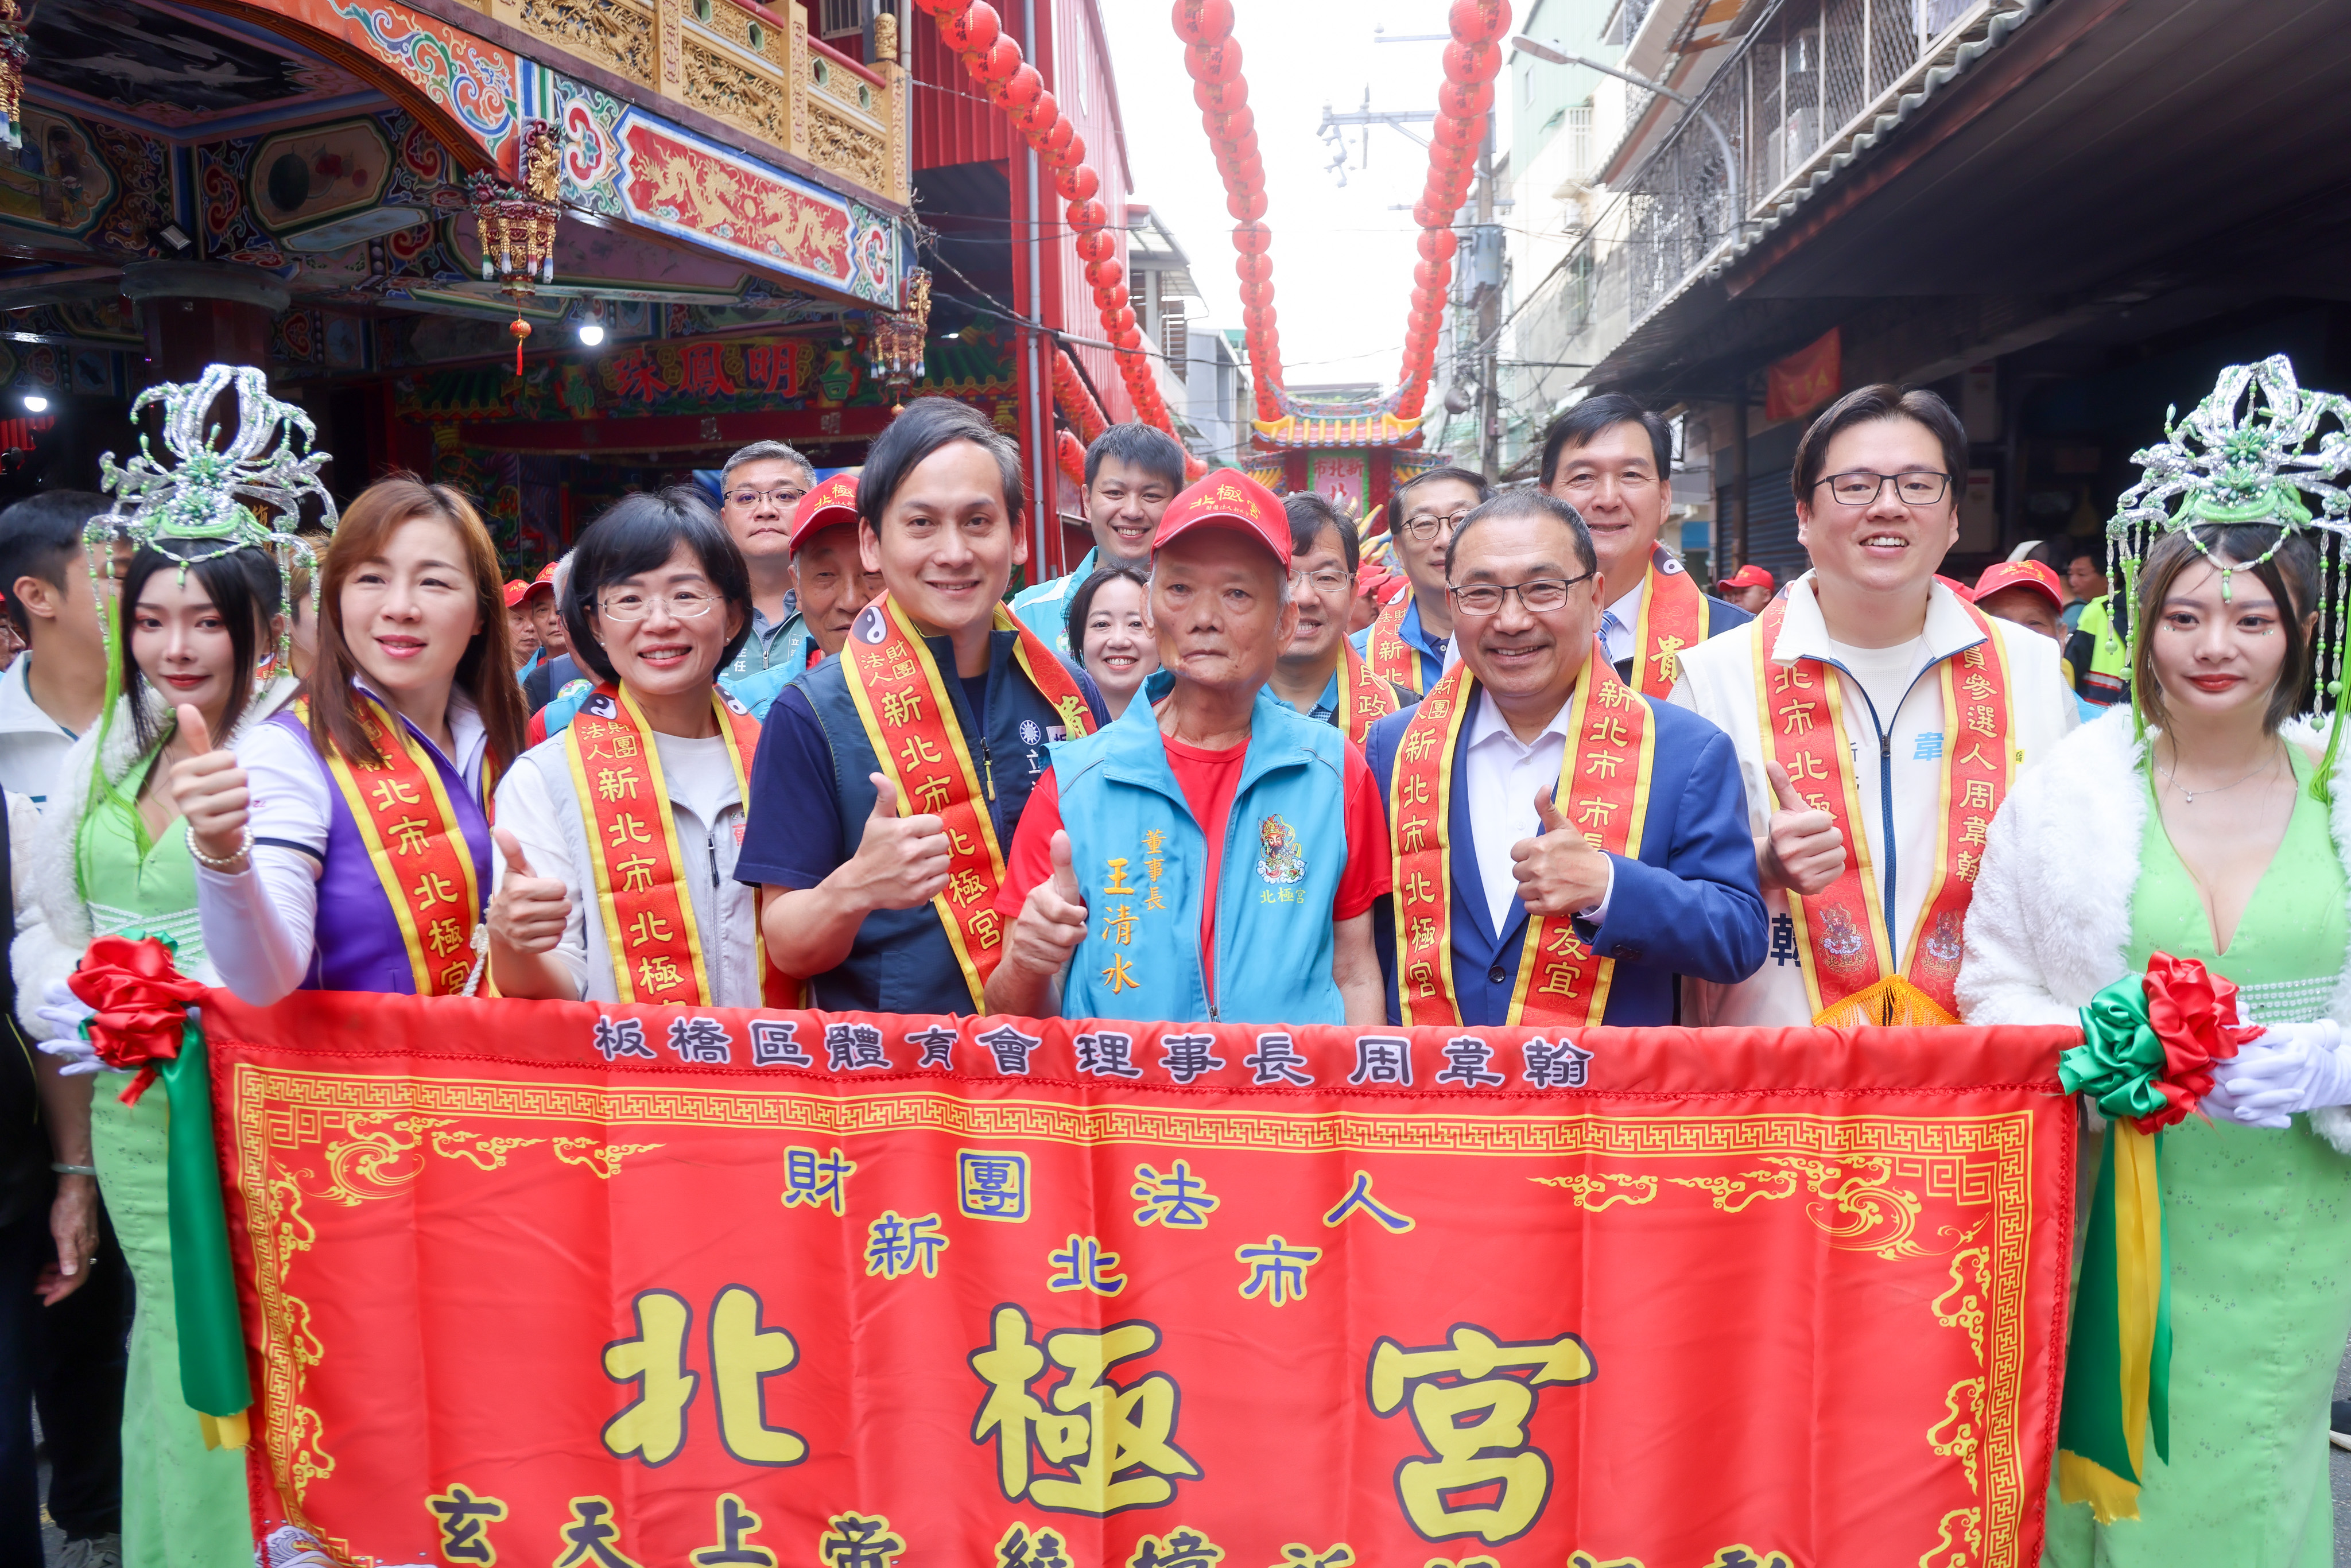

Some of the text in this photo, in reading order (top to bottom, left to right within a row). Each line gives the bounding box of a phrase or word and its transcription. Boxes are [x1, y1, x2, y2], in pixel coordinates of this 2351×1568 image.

[814, 483, 856, 511] 北極
[1189, 483, 1261, 519] 北極宮
[860, 651, 894, 688] 法人
[886, 639, 917, 680] 財團
[1427, 675, 1457, 720] 財團
[581, 721, 614, 760] 法人
[607, 721, 638, 759] 財團
[1141, 829, 1167, 911] 董事長
[1401, 727, 1437, 999] 新北市北極宮
[596, 766, 687, 1005] 新北市北極
[1260, 887, 1306, 904] 北極宮
[1101, 857, 1141, 995] 王清水
[1828, 951, 1866, 967] 北極宮
[781, 1144, 1416, 1235] 財團法人
[863, 1209, 1322, 1308] 新北市
[600, 1283, 1599, 1544] 北極宮
